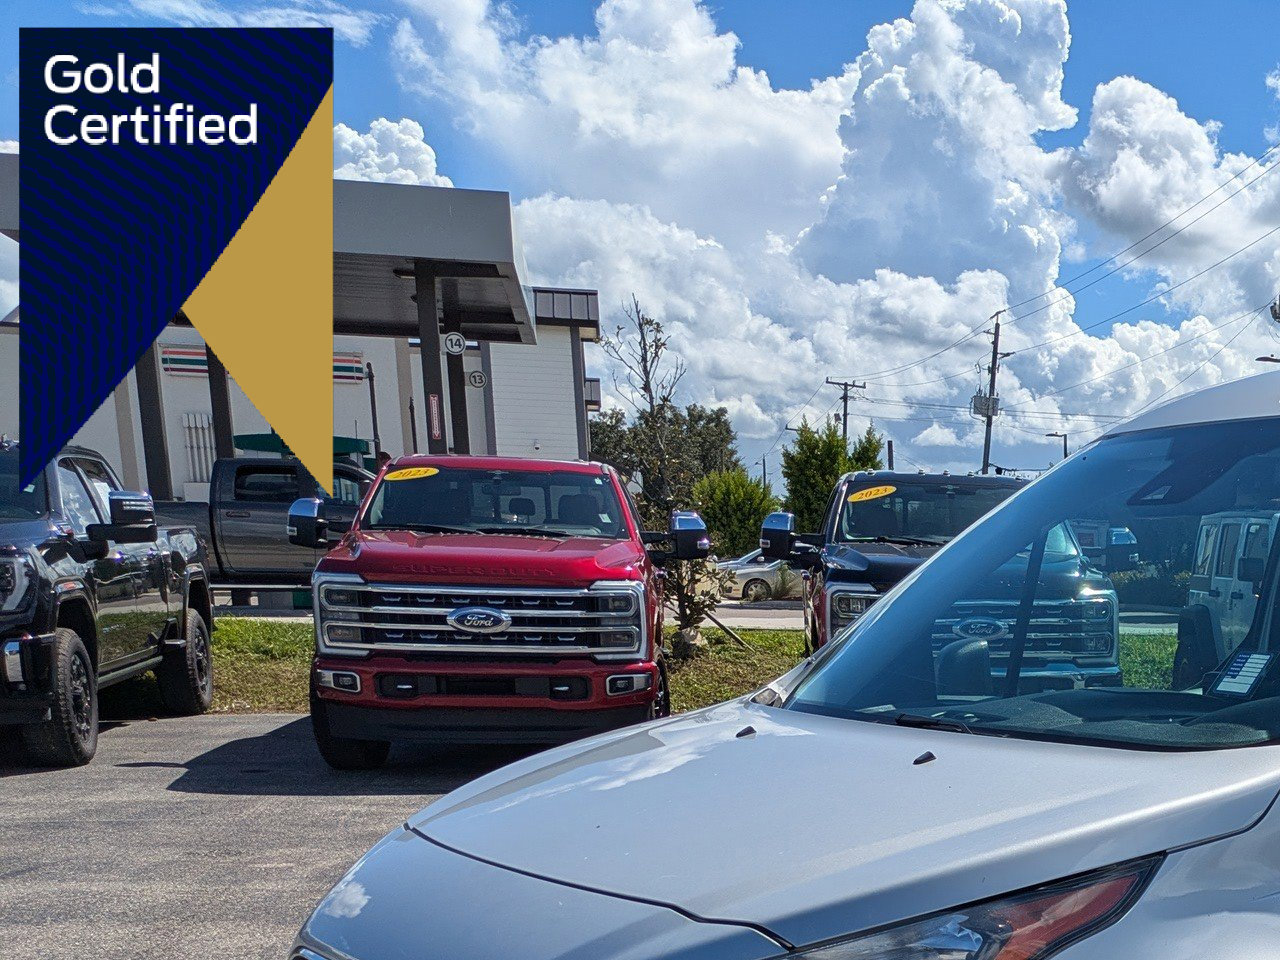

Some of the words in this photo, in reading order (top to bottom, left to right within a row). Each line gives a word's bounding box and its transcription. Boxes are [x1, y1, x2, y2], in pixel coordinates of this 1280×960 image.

[448, 338, 463, 349] 14
[472, 375, 484, 384] 13
[857, 487, 888, 500] 2023
[464, 613, 494, 627] Ford
[968, 623, 995, 635] Ford
